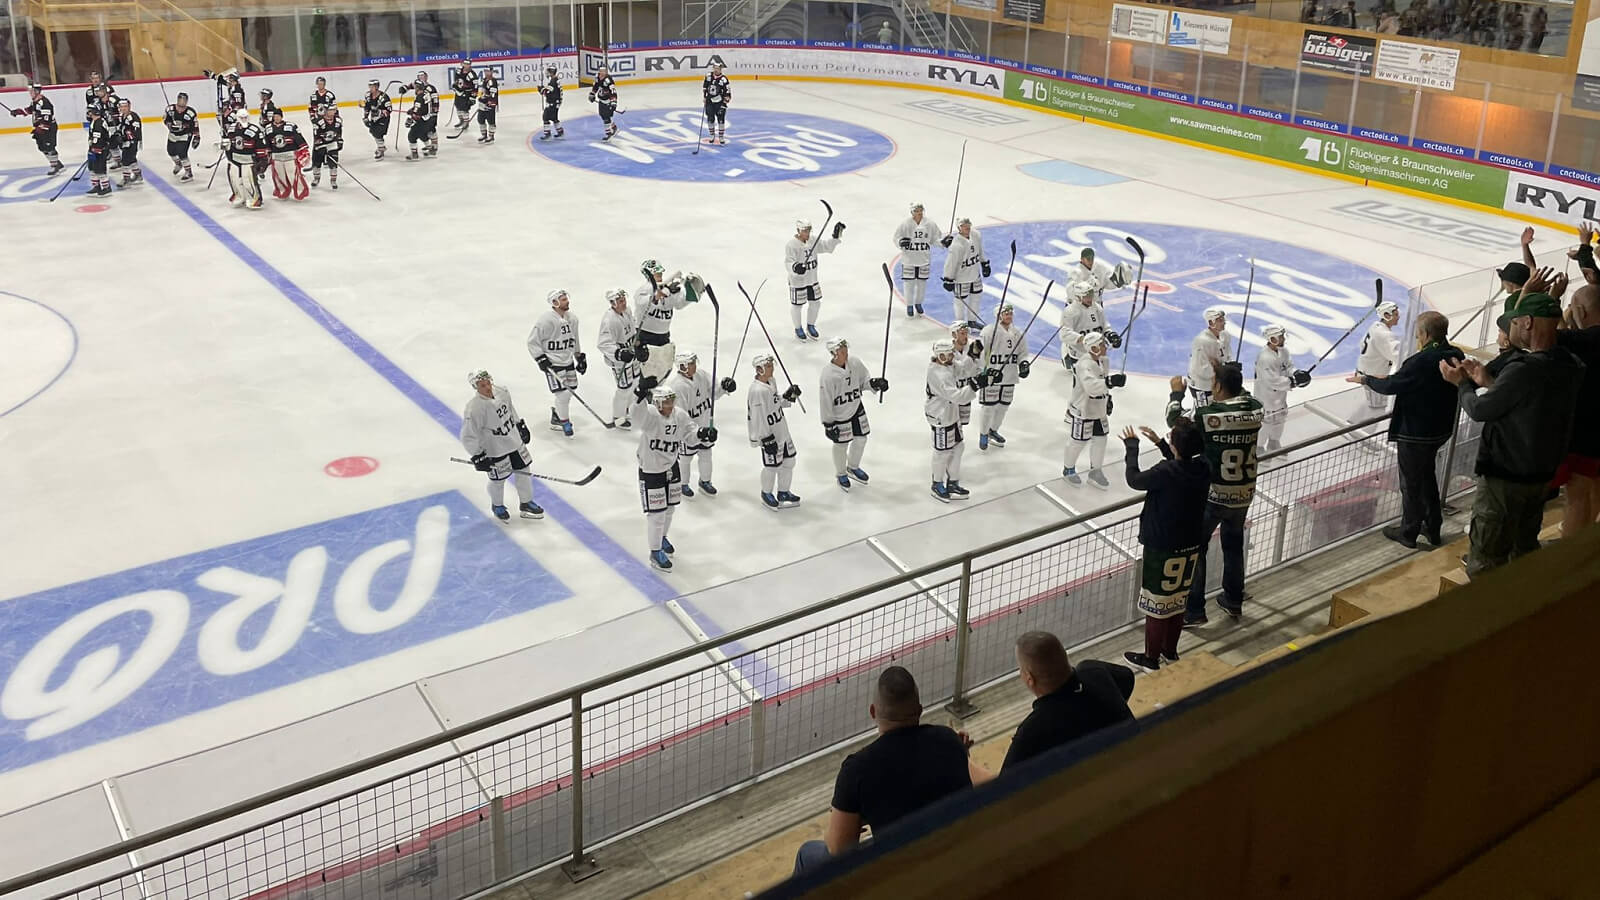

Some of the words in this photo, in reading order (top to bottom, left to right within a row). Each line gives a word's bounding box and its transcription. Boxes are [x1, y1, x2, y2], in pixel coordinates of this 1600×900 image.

[425, 53, 459, 61] cnctools.ch
[478, 50, 511, 58] cnctools.ch
[1303, 41, 1373, 62] bösiger
[370, 56, 405, 64] cnctools.ch
[645, 55, 728, 71] RYLA
[735, 61, 819, 70] Immobilien
[825, 63, 921, 77] Performance
[928, 64, 1000, 90] RYLA
[1202, 98, 1233, 110] cnctools.ch
[1107, 108, 1119, 118] AG
[1248, 107, 1282, 120] cnctools.ch
[1170, 116, 1262, 141] www.sawmachines.com
[1302, 118, 1339, 131] cnctools.ch
[1360, 128, 1399, 143] cnctools.ch
[1423, 141, 1464, 155] cnctools.ch
[1393, 155, 1399, 165] &
[1401, 156, 1475, 181] Braunschweiler
[1489, 154, 1534, 169] cnctools.ch
[1432, 179, 1449, 189] AG
[914, 231, 924, 239] 12
[560, 324, 571, 335] 31
[547, 338, 577, 352] OLTE
[1007, 340, 1013, 349] 3
[990, 353, 1018, 365] OLTE
[845, 377, 851, 386] 7
[496, 404, 508, 418] 22
[665, 424, 677, 435] 27
[1161, 552, 1200, 591] 91
